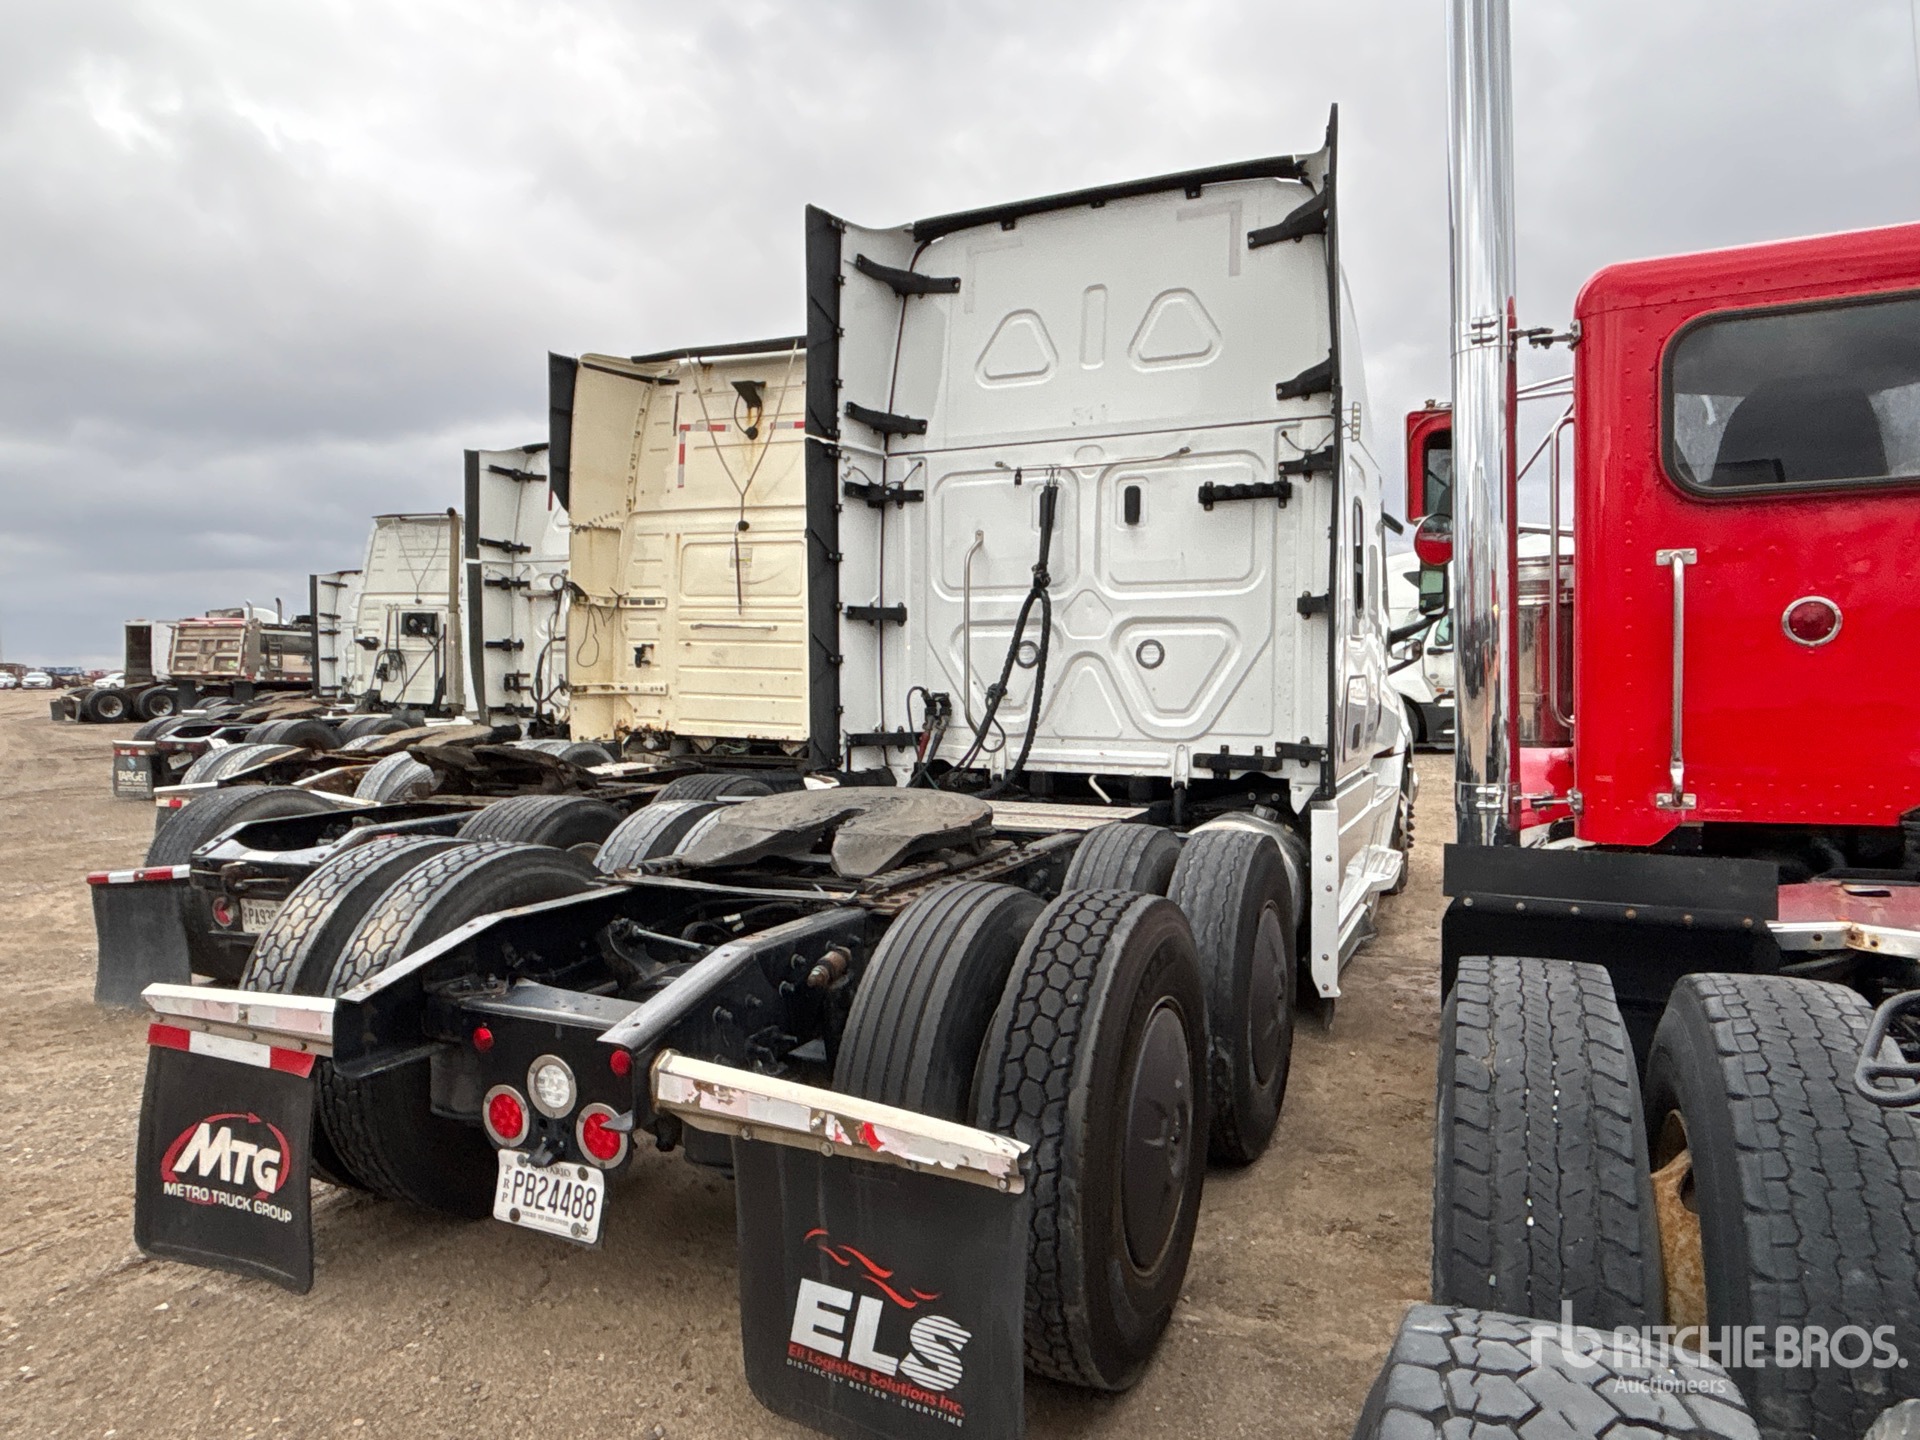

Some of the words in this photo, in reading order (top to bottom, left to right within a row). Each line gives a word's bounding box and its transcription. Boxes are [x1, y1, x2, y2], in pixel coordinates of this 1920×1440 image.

[117, 770, 148, 782] TARGET
[172, 1122, 281, 1194] MTG
[163, 1182, 210, 1202] METRO
[211, 1188, 252, 1212] TRUCK
[254, 1200, 292, 1224] GROUP
[511, 1170, 597, 1222] PB24488
[790, 1278, 973, 1392] ELS
[786, 1358, 845, 1384] DISTINCTLY
[848, 1381, 888, 1401] BETTER
[900, 1398, 964, 1428] EVERYTIME
[808, 1350, 867, 1383] Logistics
[869, 1371, 937, 1405] Solutions
[940, 1395, 966, 1417] Inc.
